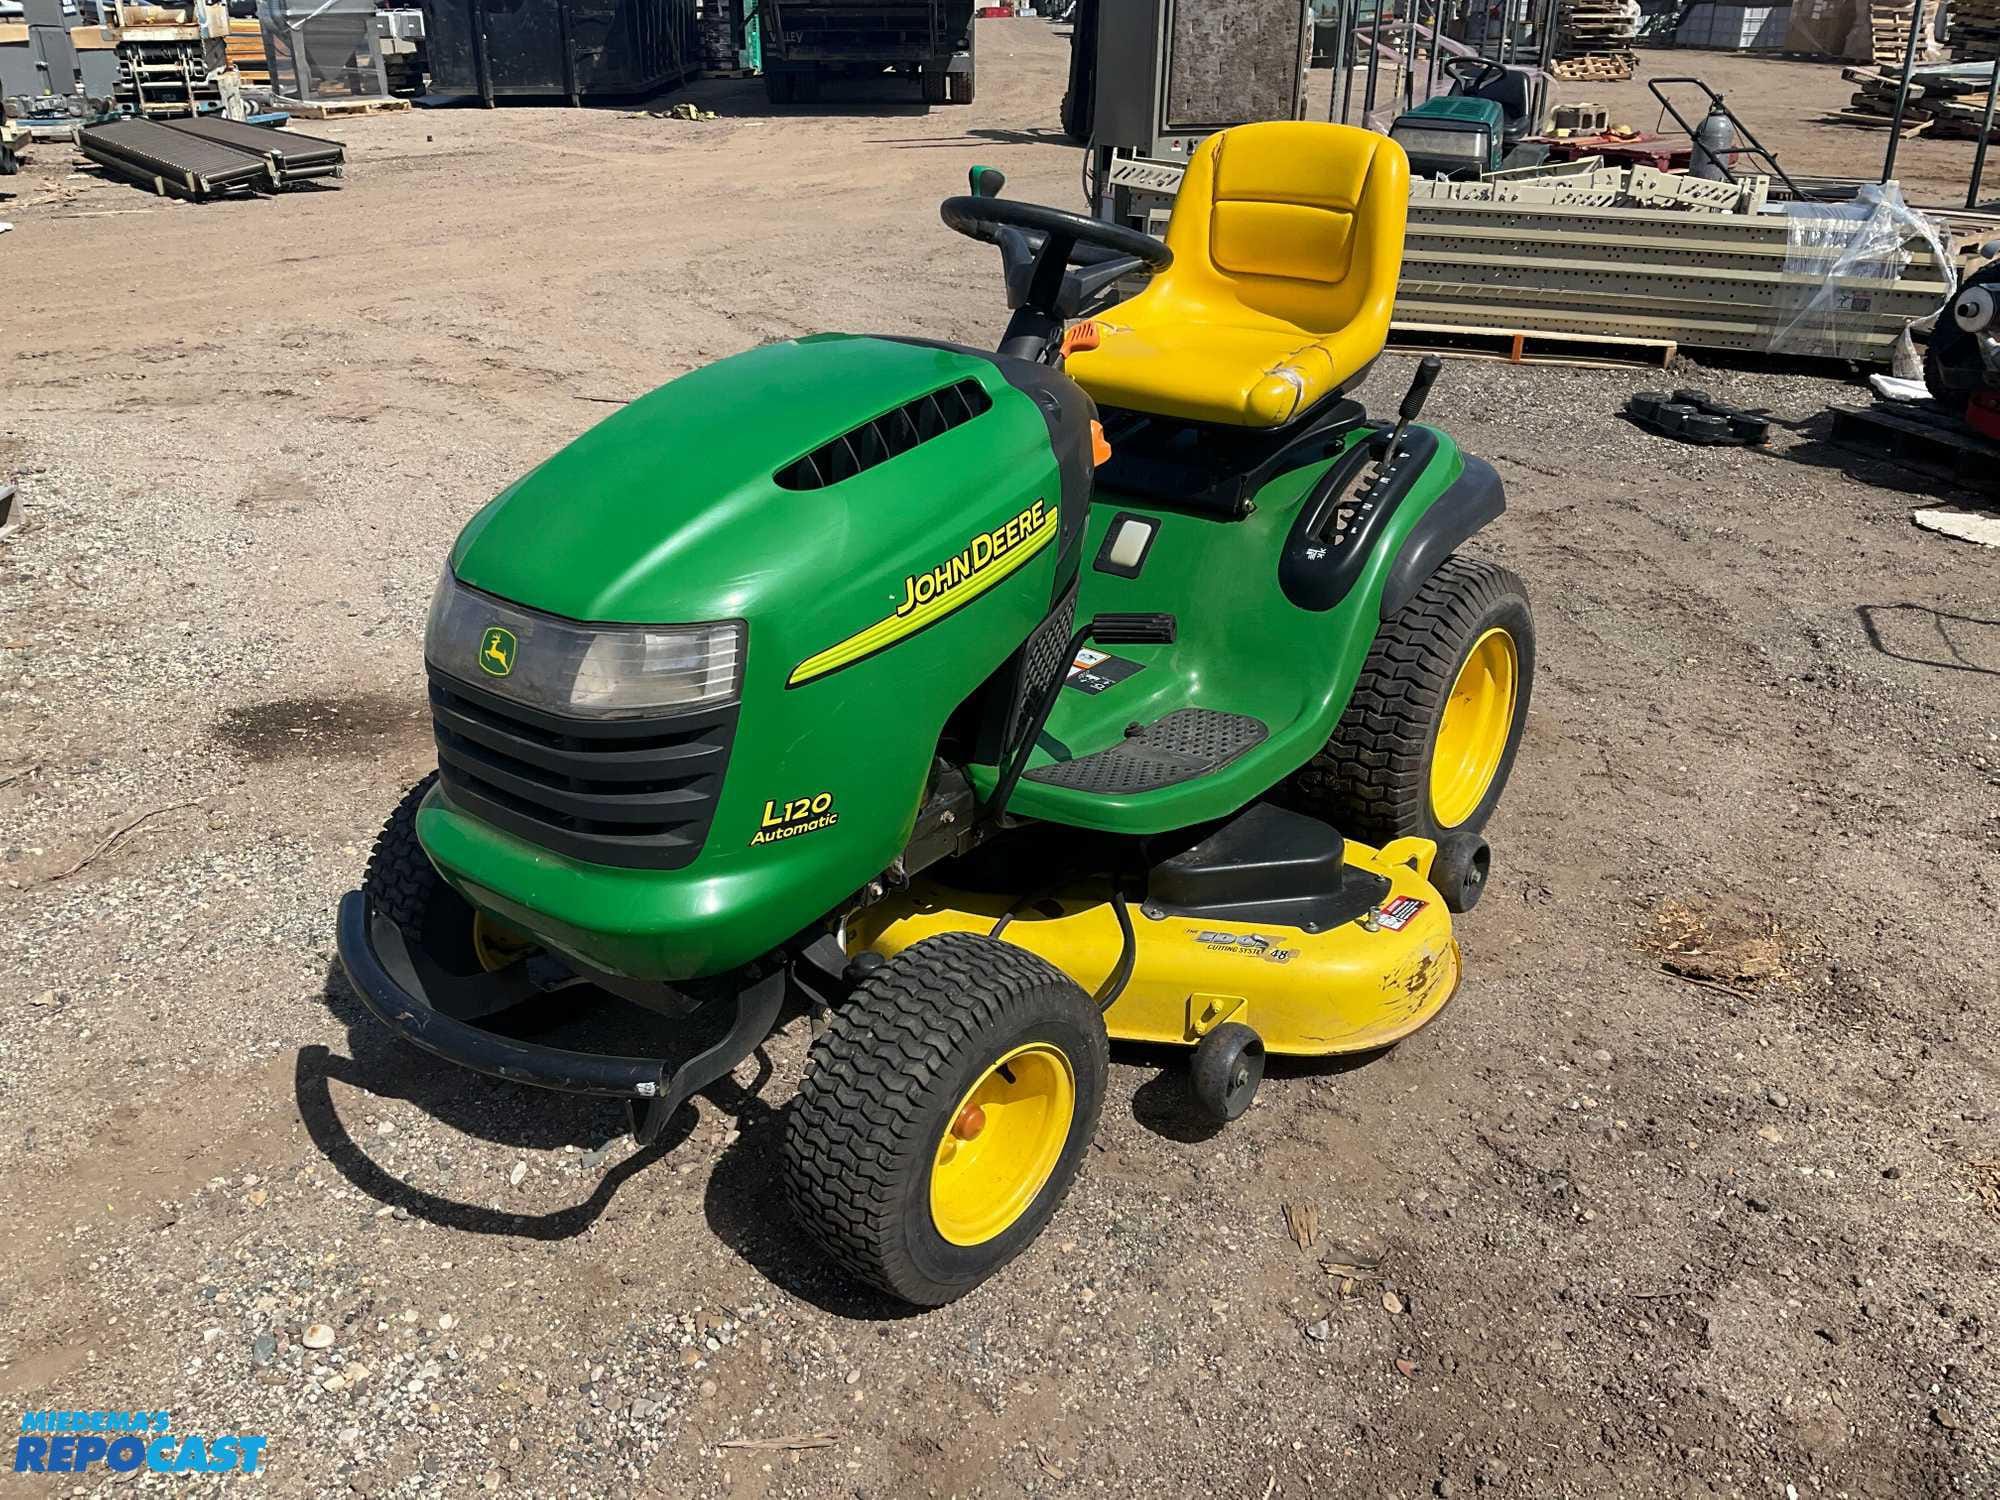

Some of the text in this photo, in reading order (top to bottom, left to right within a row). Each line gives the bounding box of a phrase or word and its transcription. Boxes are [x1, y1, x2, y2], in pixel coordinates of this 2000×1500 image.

[769, 31, 804, 42] VLLEY
[896, 497, 1045, 616] JOHN DEERE
[761, 792, 833, 828] L120
[750, 812, 839, 847] Automatic
[1206, 943, 1289, 961] CUTTING SYSTE 48
